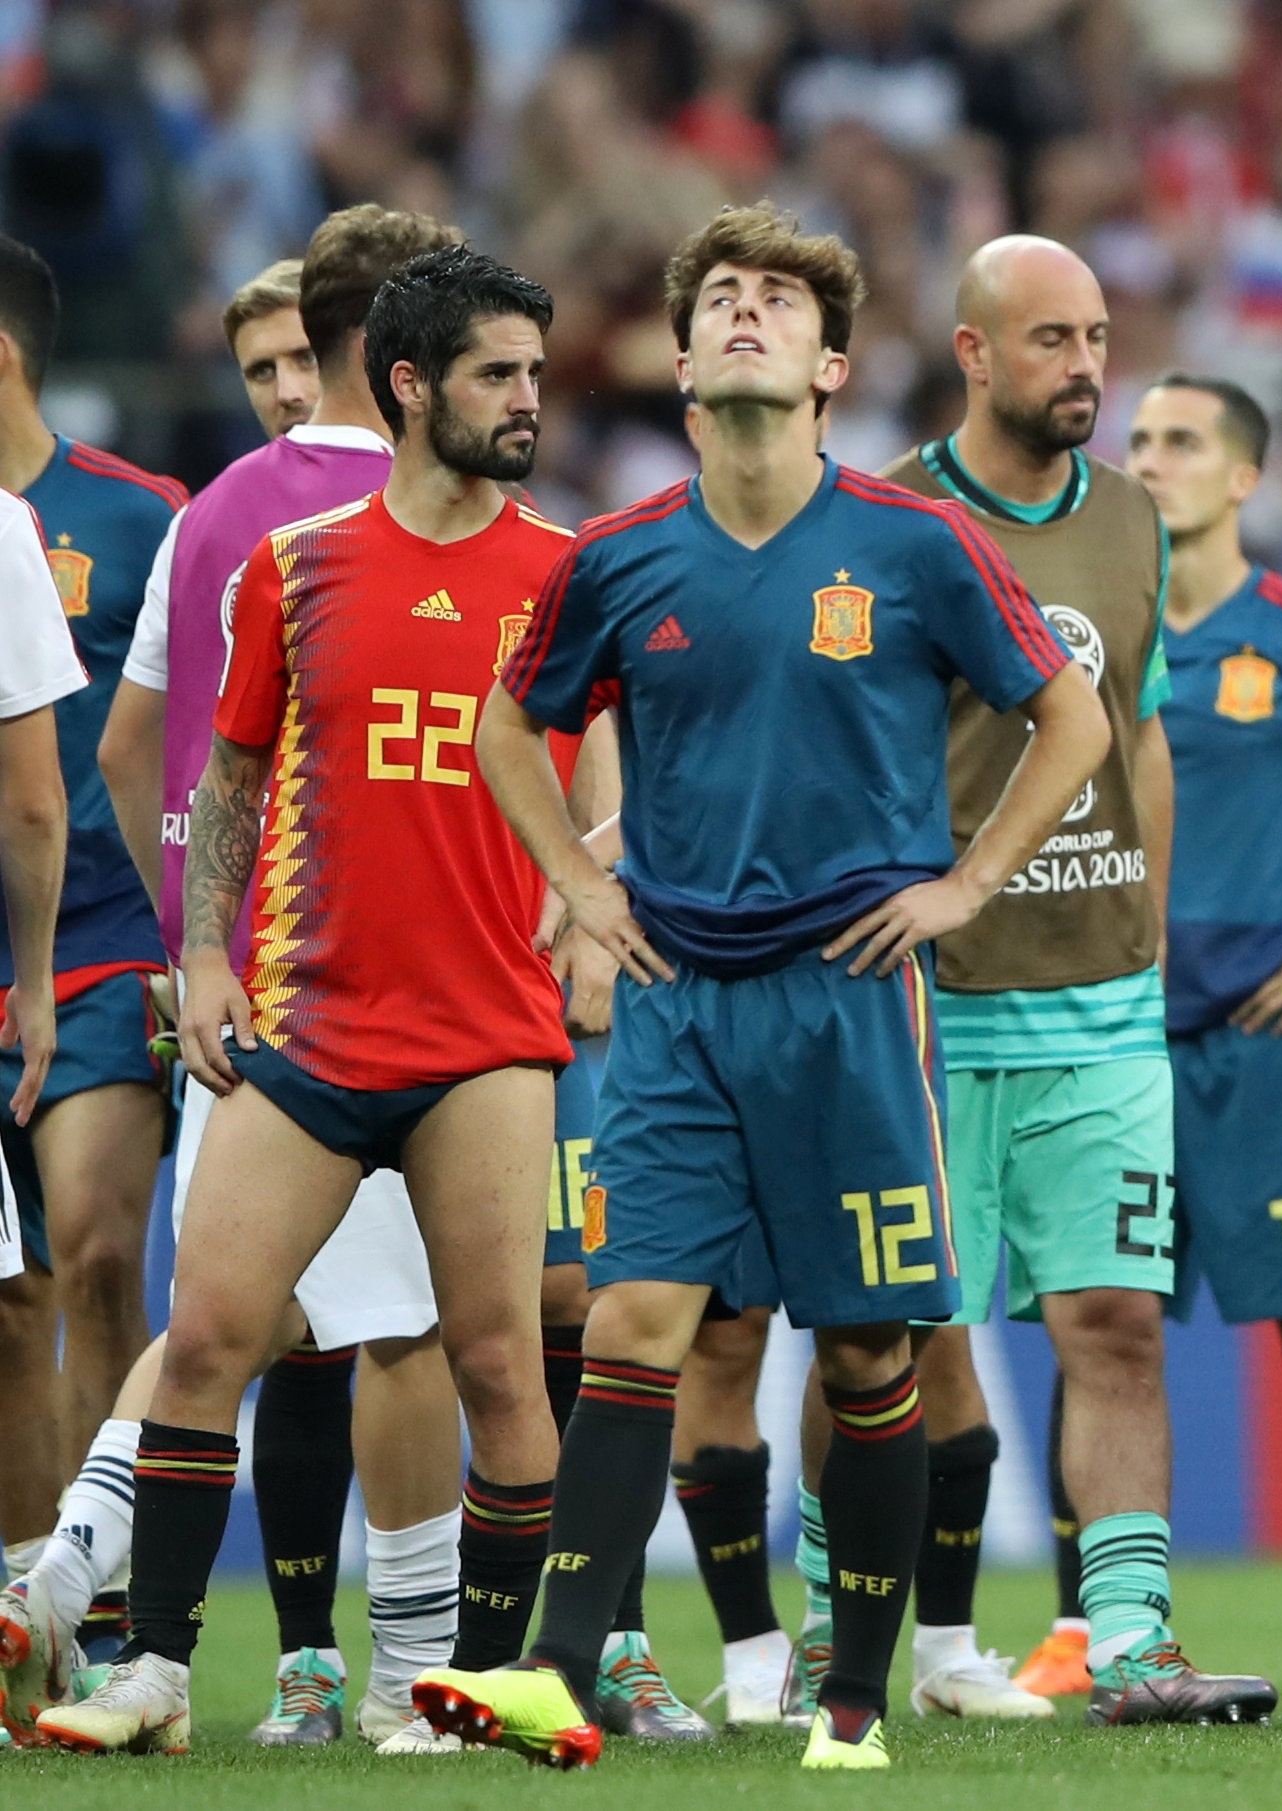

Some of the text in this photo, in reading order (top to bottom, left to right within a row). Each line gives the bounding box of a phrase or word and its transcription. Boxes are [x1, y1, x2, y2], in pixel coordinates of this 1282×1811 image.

[411, 604, 462, 622] adidas
[367, 687, 478, 788] 22
[1089, 848, 1146, 889] 2018
[841, 1184, 937, 1287] 12
[544, 1552, 591, 1574] FEF
[838, 1569, 897, 1597] RFEF
